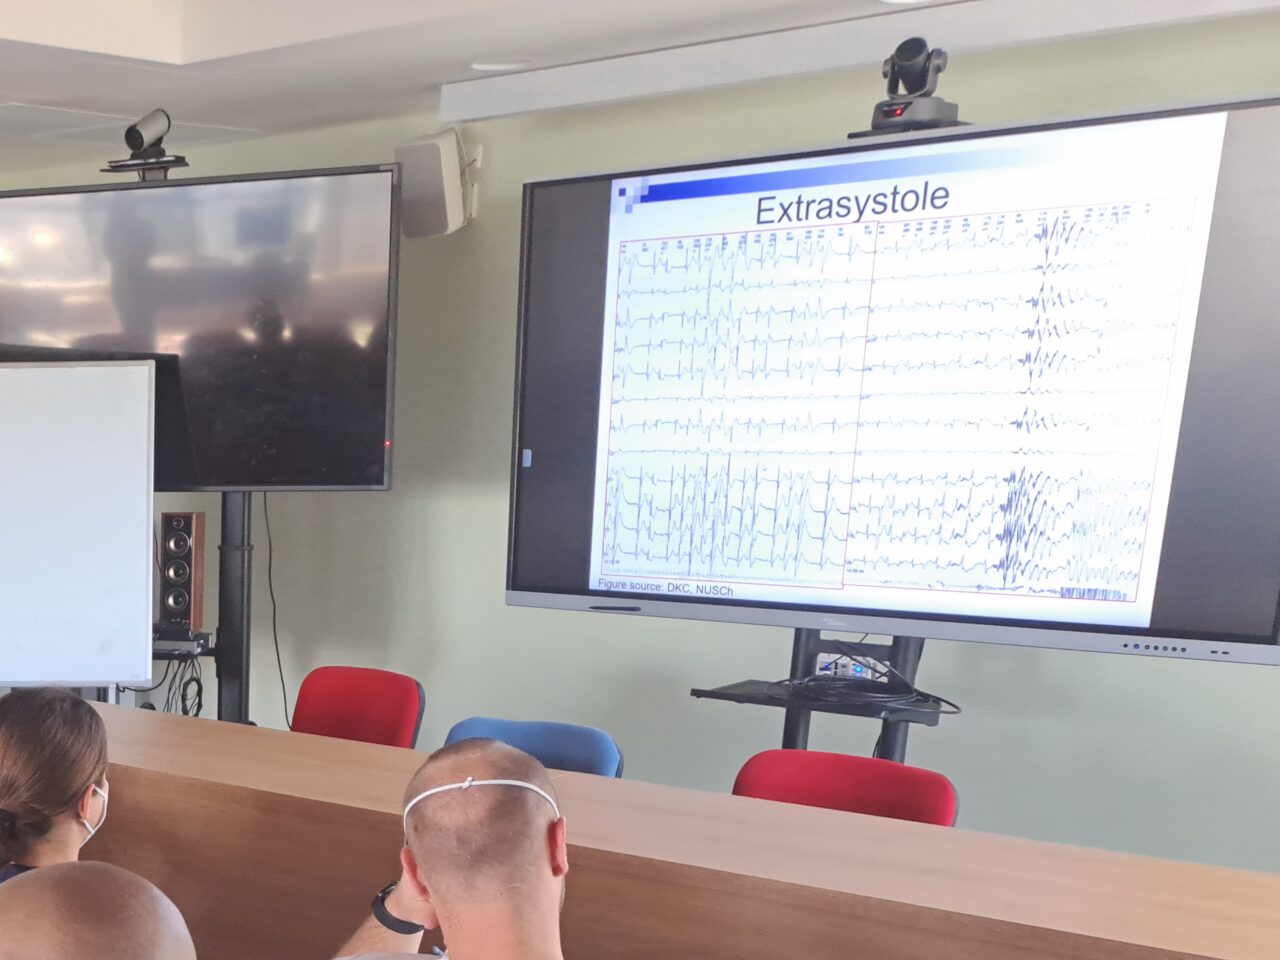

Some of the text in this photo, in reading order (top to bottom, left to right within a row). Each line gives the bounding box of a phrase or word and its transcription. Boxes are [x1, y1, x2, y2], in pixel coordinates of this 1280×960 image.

[755, 181, 950, 224] Extrasystole
[598, 578, 734, 597] Figure source: DKC, NUSCh
